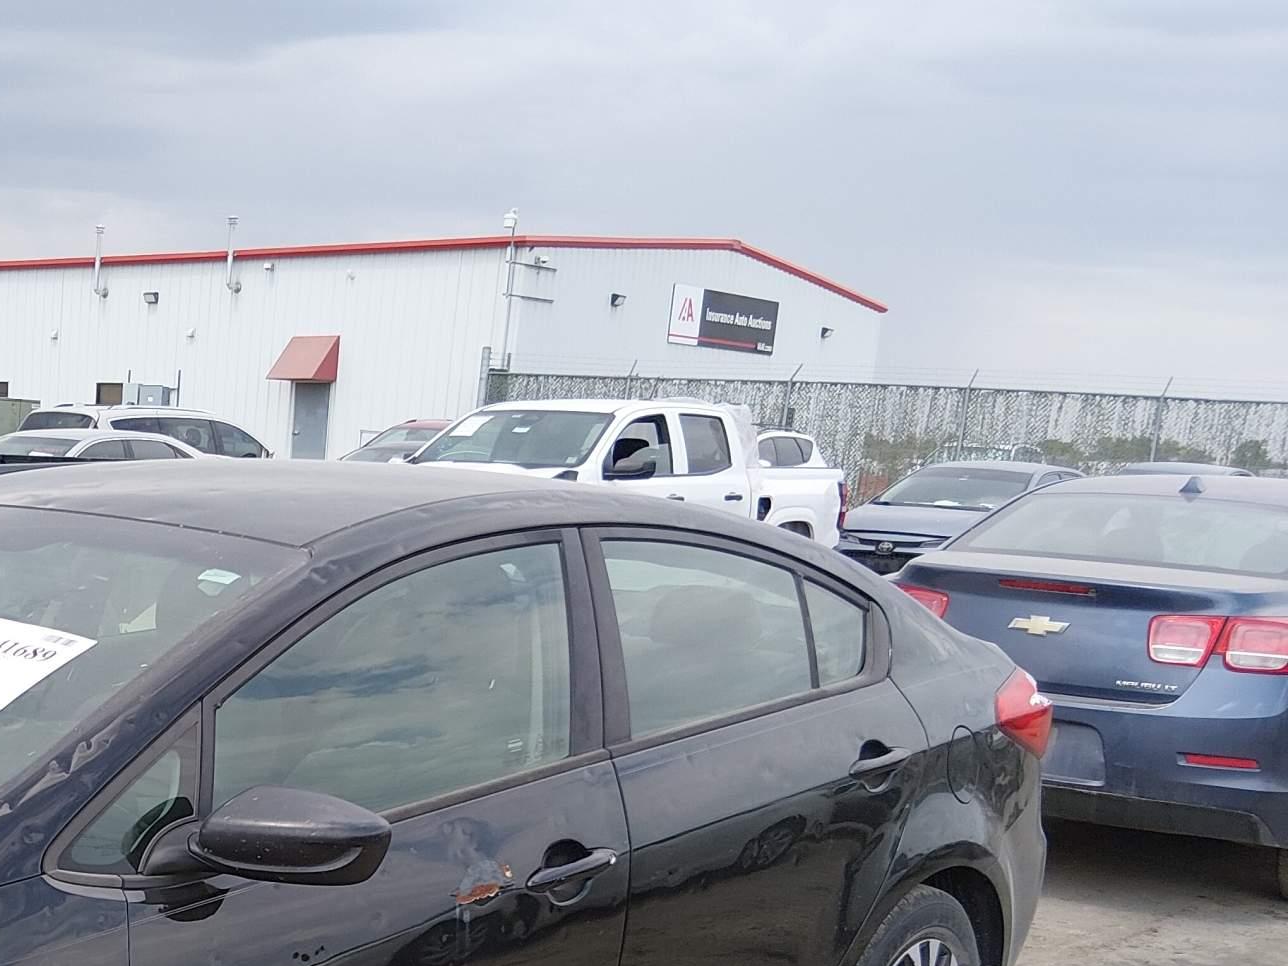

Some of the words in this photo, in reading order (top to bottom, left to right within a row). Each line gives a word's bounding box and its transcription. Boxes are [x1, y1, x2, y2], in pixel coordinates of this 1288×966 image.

[705, 307, 734, 325] Insurance
[734, 312, 748, 327] Auto
[748, 314, 772, 330] Auctions
